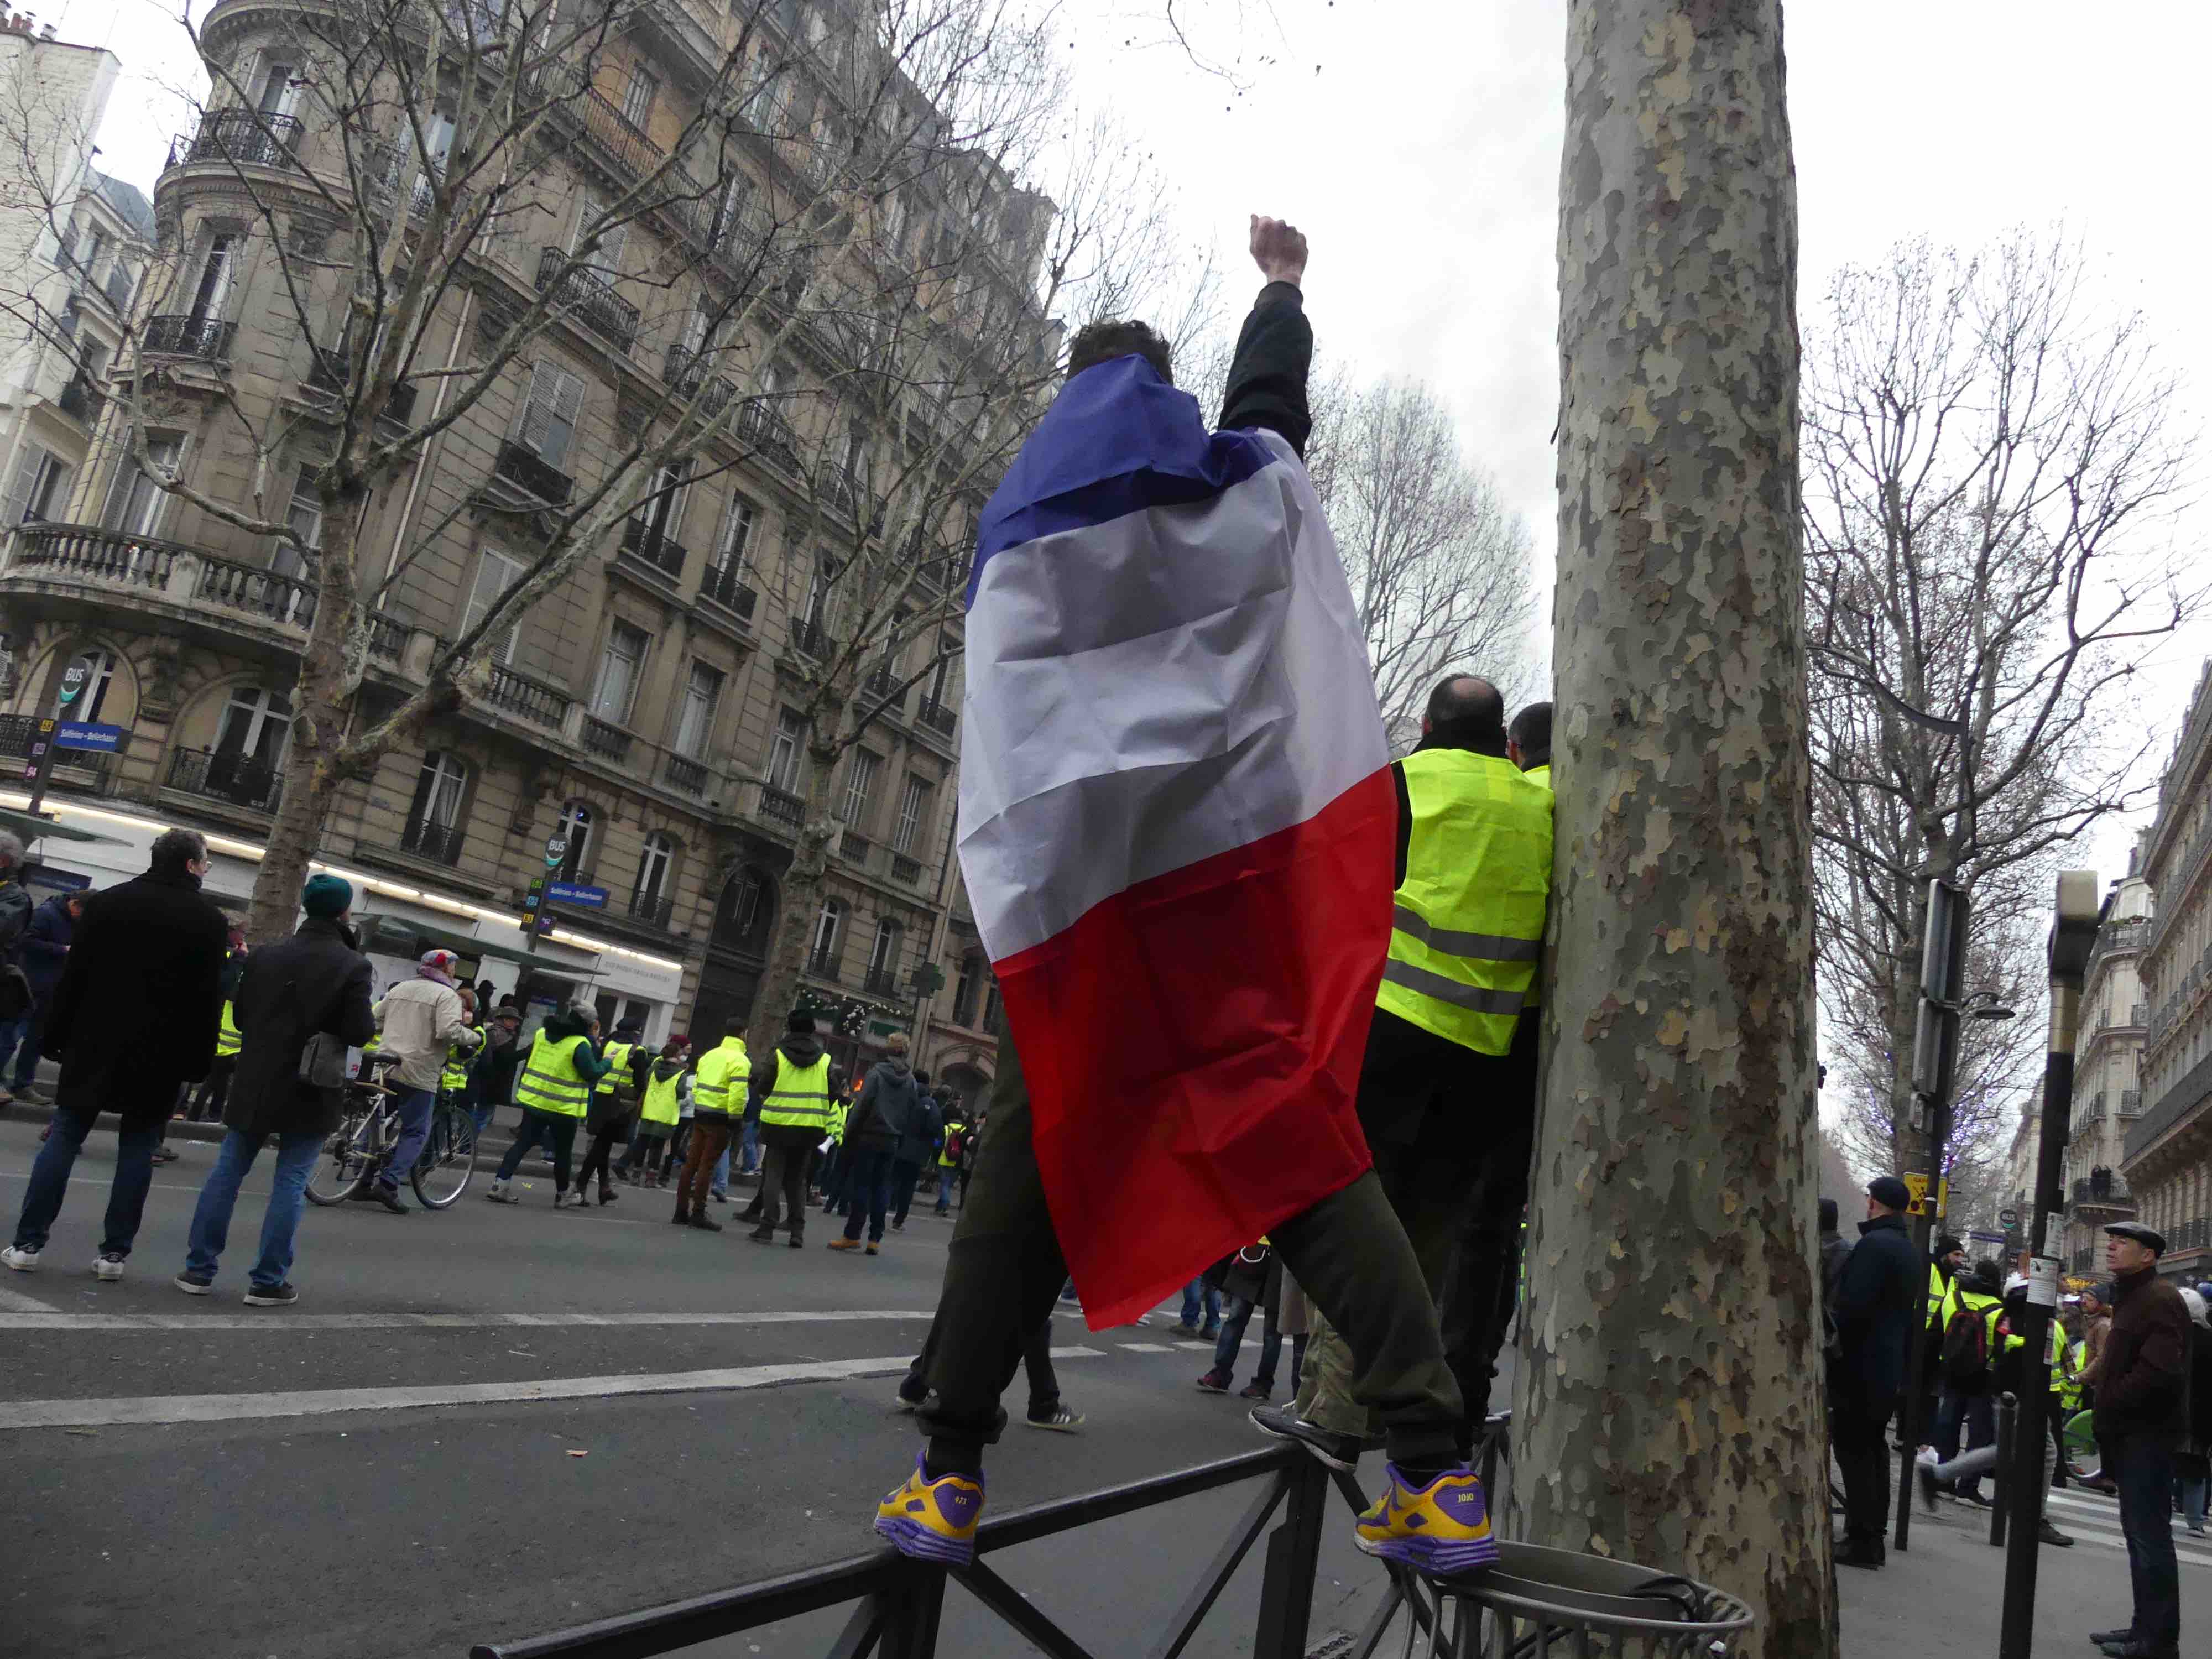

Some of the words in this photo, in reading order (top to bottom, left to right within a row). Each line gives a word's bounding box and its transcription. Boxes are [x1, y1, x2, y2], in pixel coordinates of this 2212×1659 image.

[65, 667, 85, 682] BUS
[549, 839, 566, 852] BUS
[1458, 1493, 1474, 1503] JOJO
